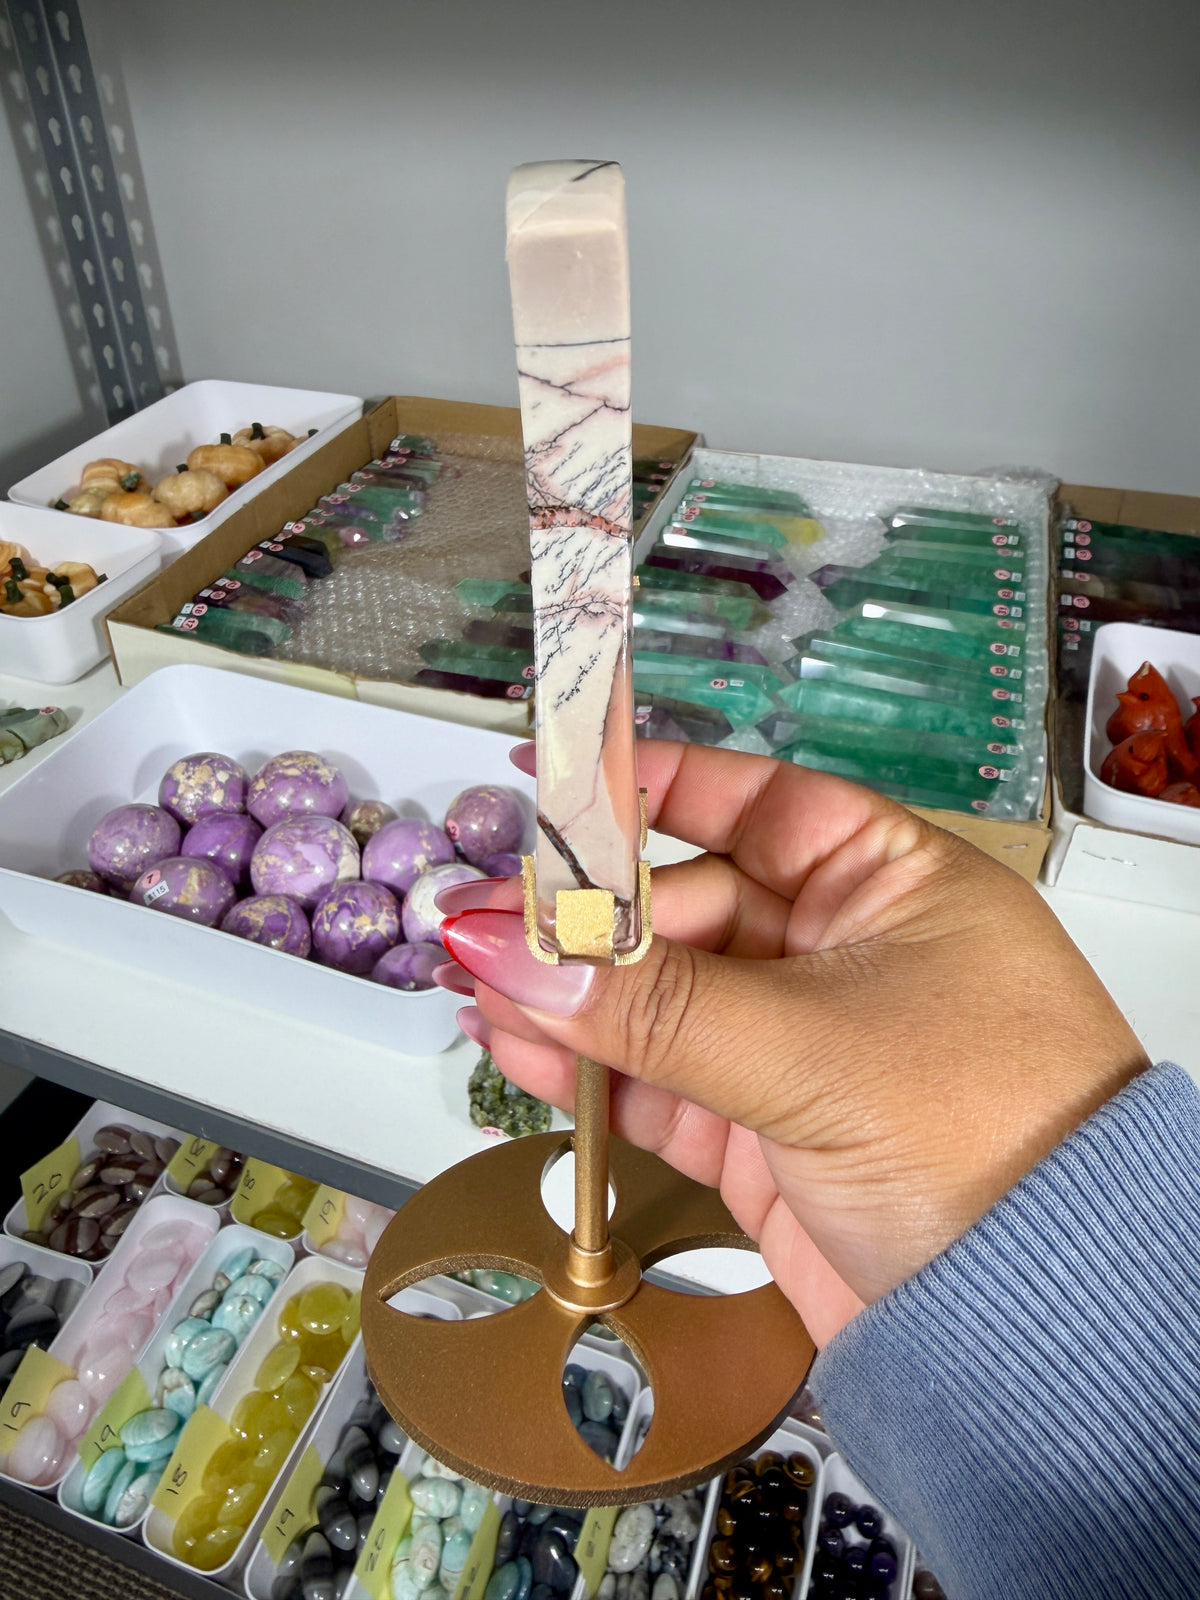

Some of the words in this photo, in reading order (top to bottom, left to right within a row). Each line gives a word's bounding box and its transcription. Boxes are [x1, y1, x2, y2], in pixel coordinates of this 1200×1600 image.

[147, 885, 167, 902] $115
[31, 1172, 63, 1205] 20
[319, 1199, 338, 1225] 19
[2, 1401, 32, 1432] 19
[93, 1424, 117, 1454] 19
[165, 1462, 189, 1496] 18
[275, 1507, 296, 1537] 19
